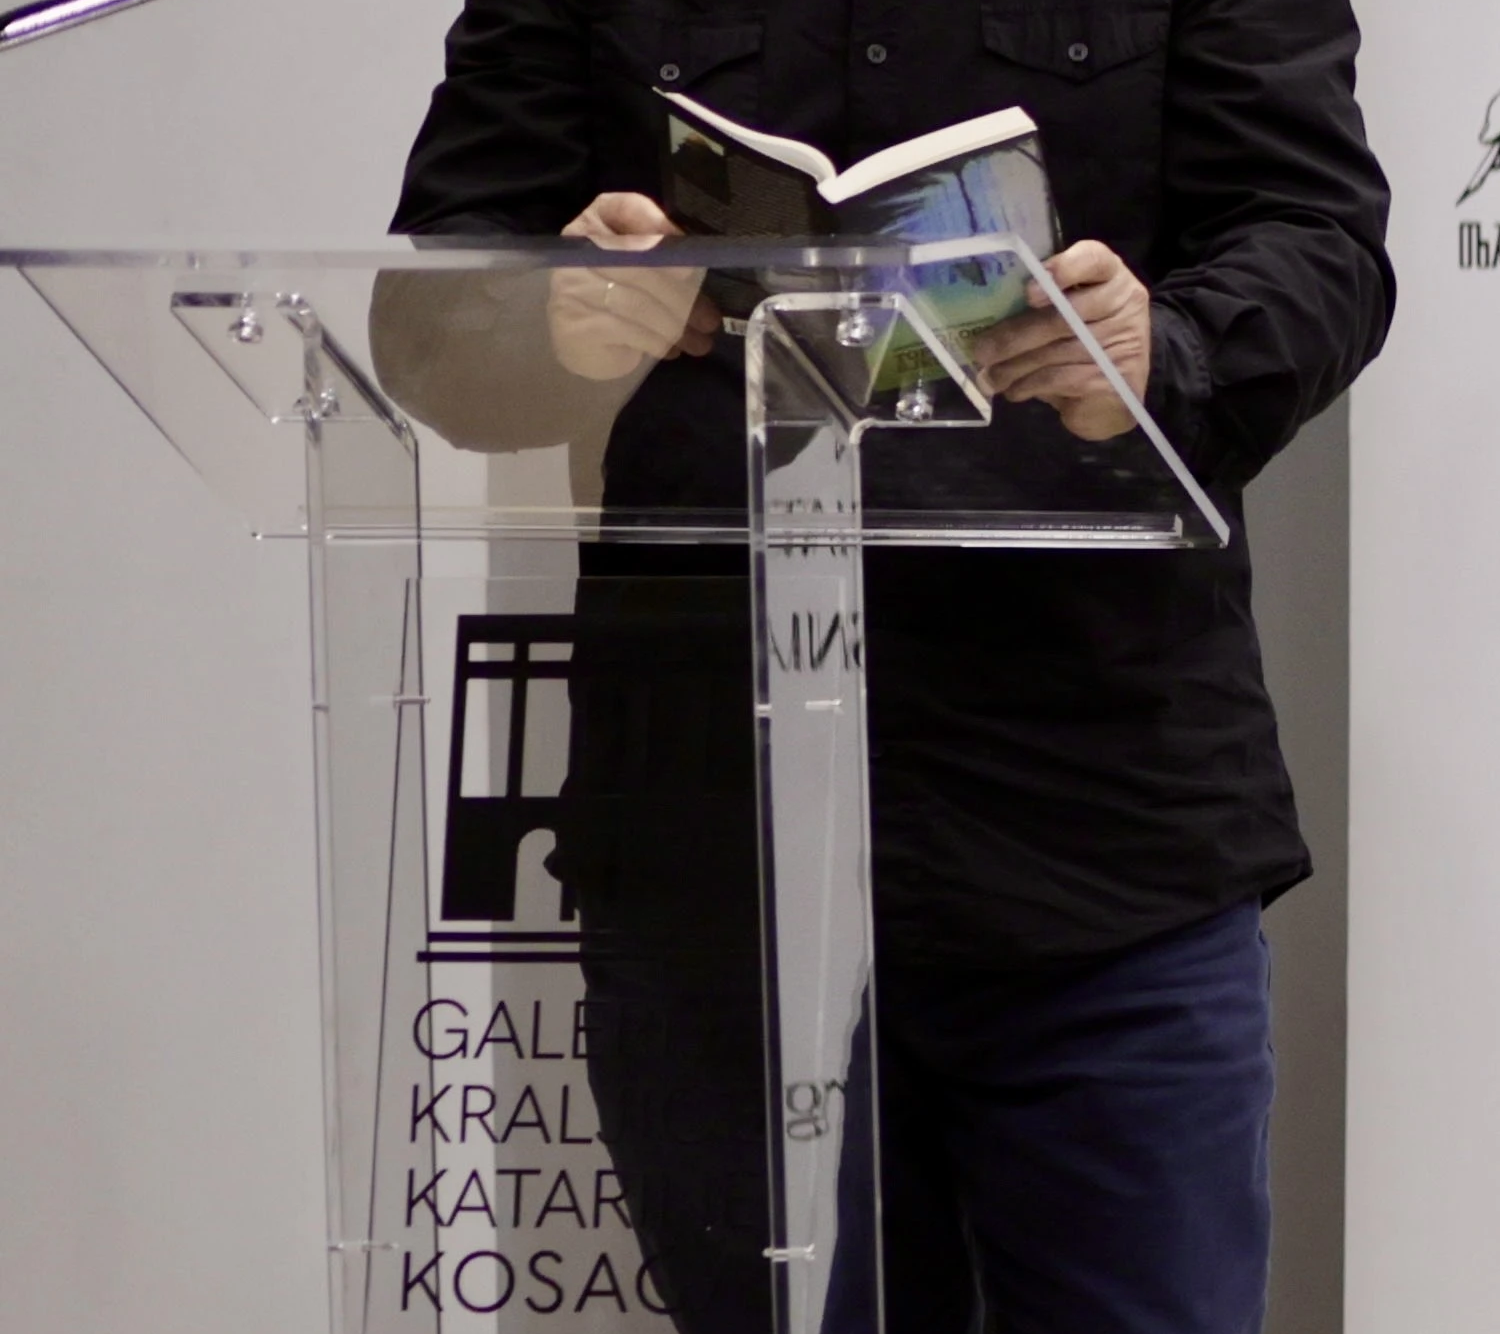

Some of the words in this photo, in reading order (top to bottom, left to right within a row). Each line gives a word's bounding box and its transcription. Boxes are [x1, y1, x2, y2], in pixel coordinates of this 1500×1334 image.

[413, 998, 600, 1060] GALE
[409, 1084, 600, 1144] KRAL
[405, 1168, 636, 1229] KATAR
